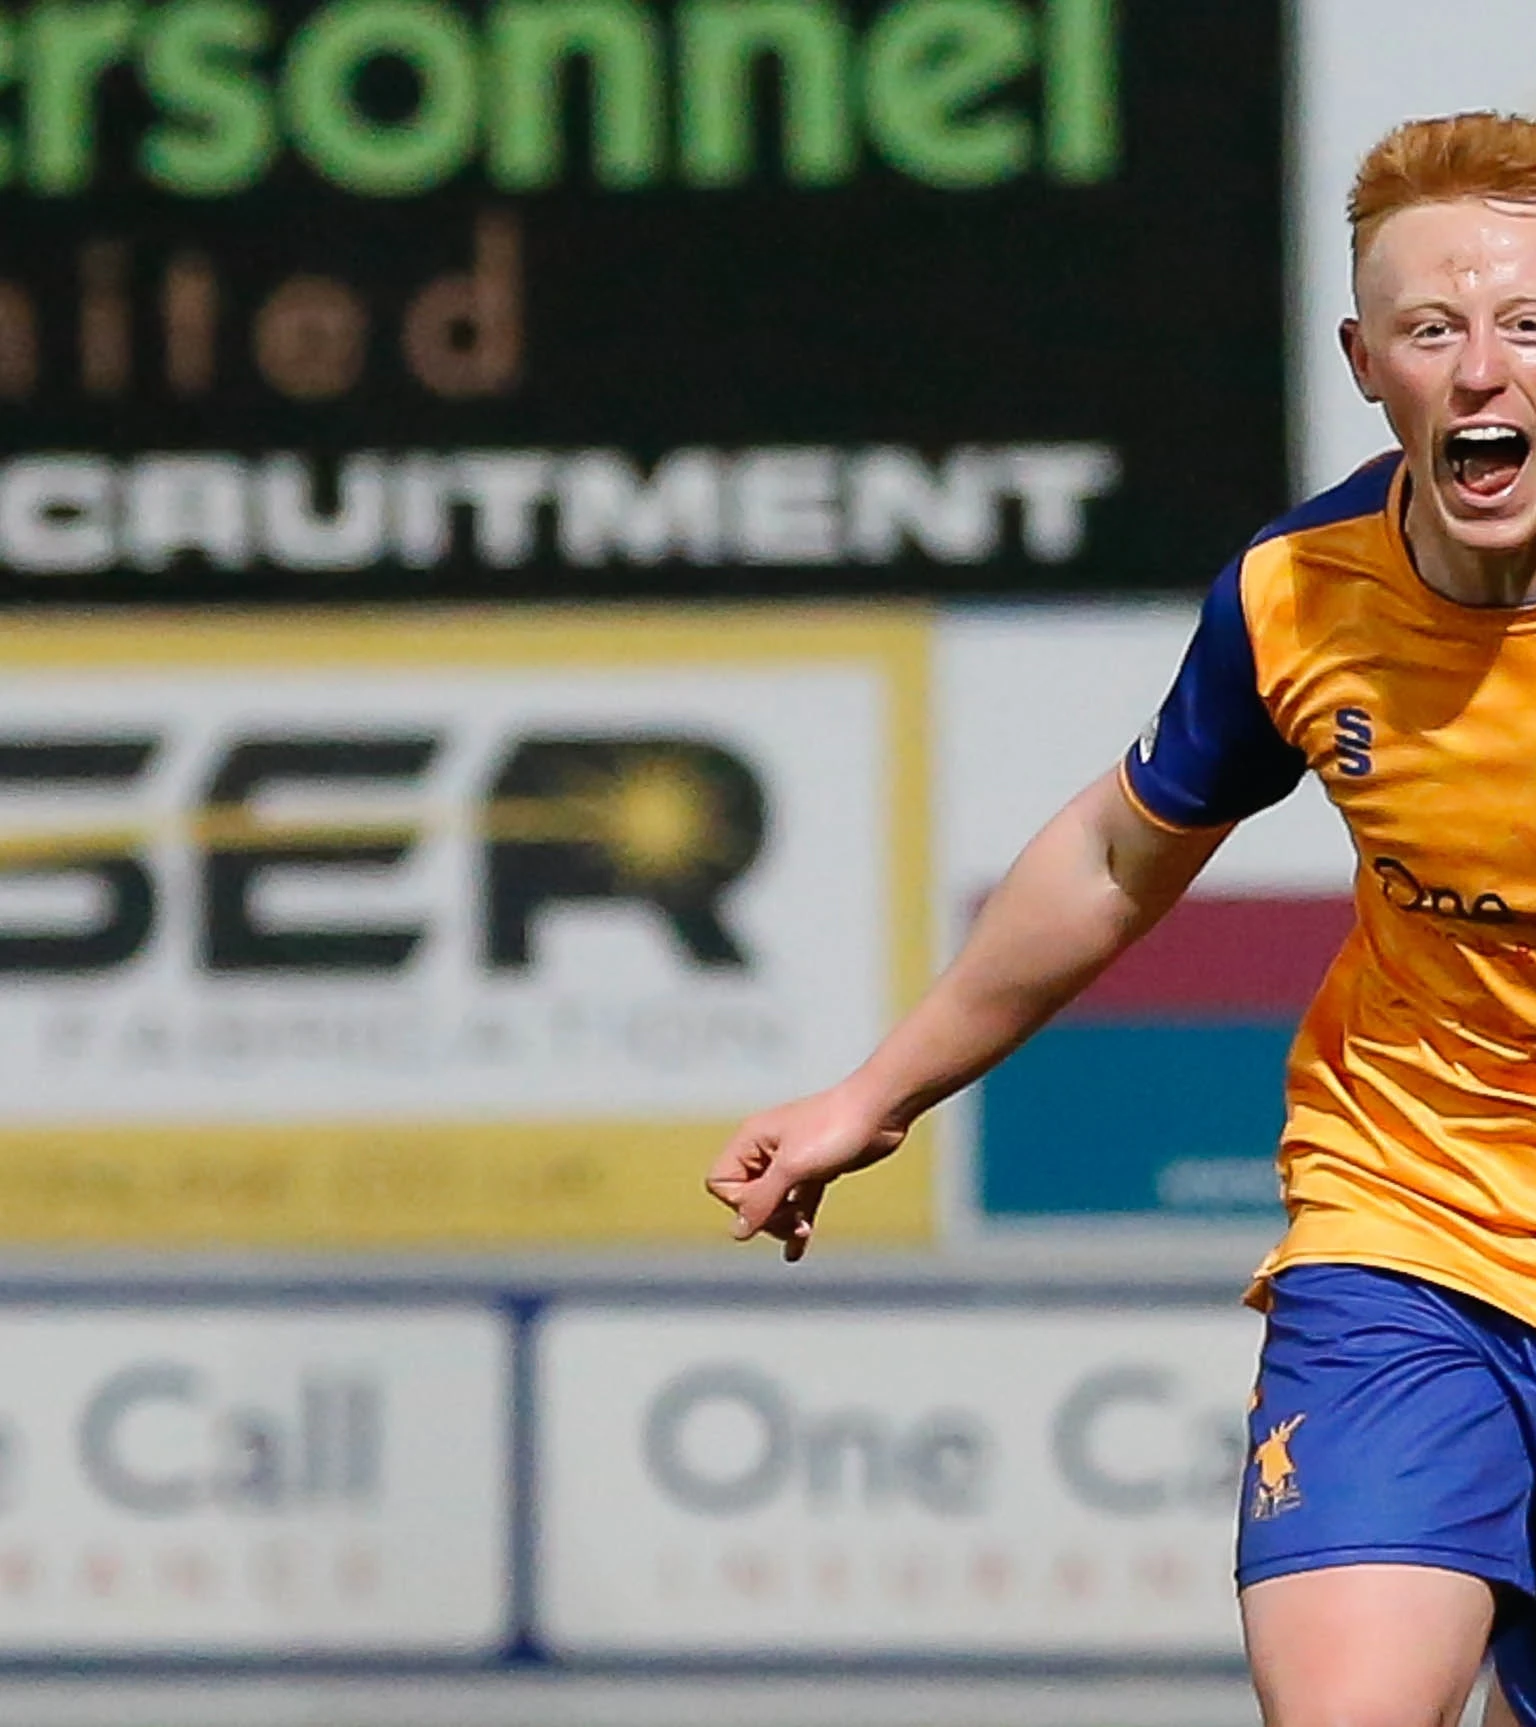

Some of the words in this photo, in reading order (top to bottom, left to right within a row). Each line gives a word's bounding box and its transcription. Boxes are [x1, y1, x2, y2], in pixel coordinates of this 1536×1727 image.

[0, 0, 1120, 192] rsonnel
[1373, 856, 1512, 922] One
[73, 1357, 388, 1521] Call
[642, 1360, 990, 1521] One
